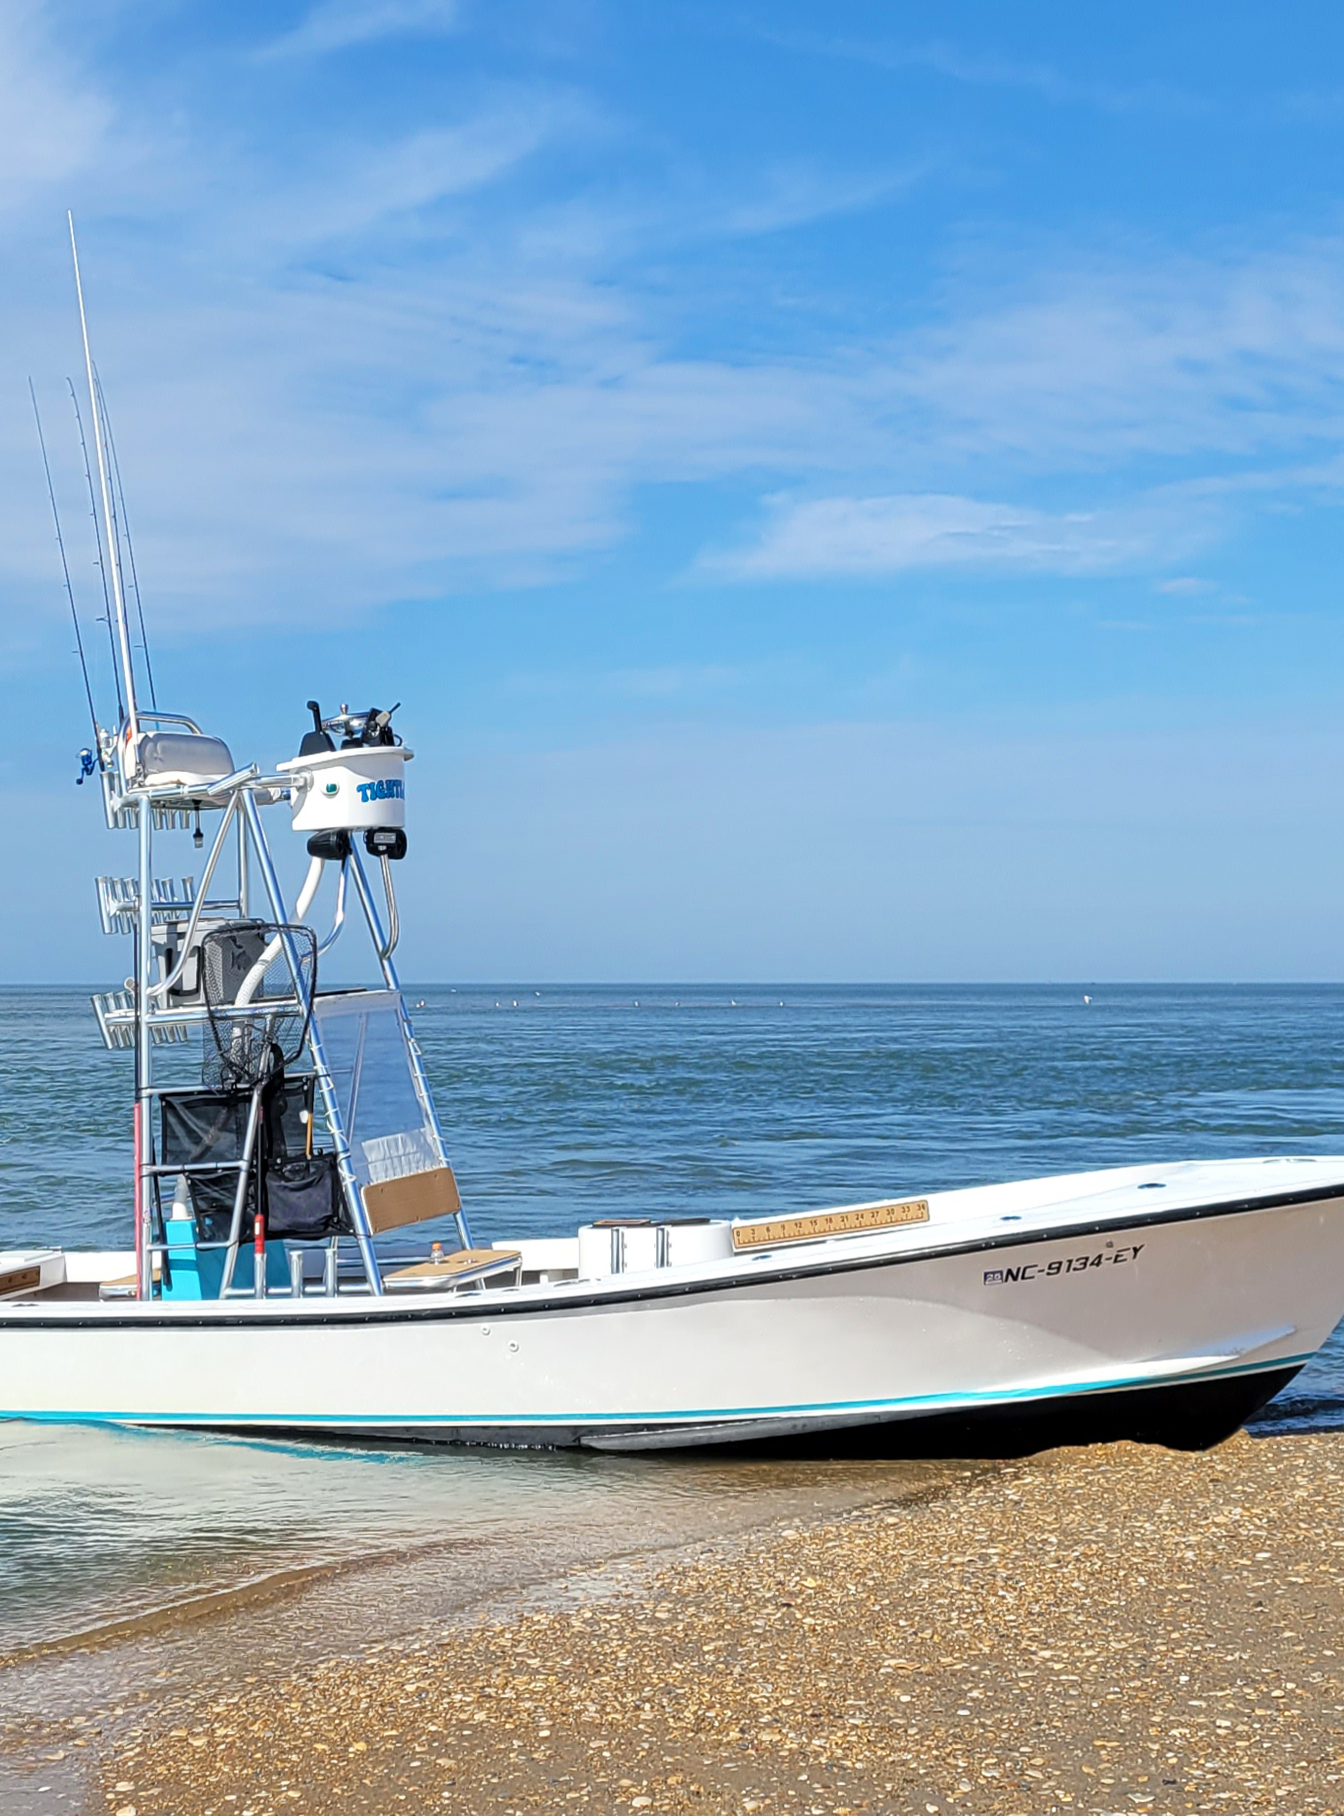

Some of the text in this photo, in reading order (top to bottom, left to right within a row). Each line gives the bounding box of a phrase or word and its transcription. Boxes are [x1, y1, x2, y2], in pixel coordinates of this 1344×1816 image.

[356, 779, 405, 803] TIGHTL
[810, 1219, 818, 1227] 15
[825, 1217, 833, 1225] 18
[886, 1208, 894, 1216] 30
[902, 1205, 910, 1213] 33
[917, 1203, 925, 1211] 36
[1004, 1244, 1146, 1283] NC-9134-EY
